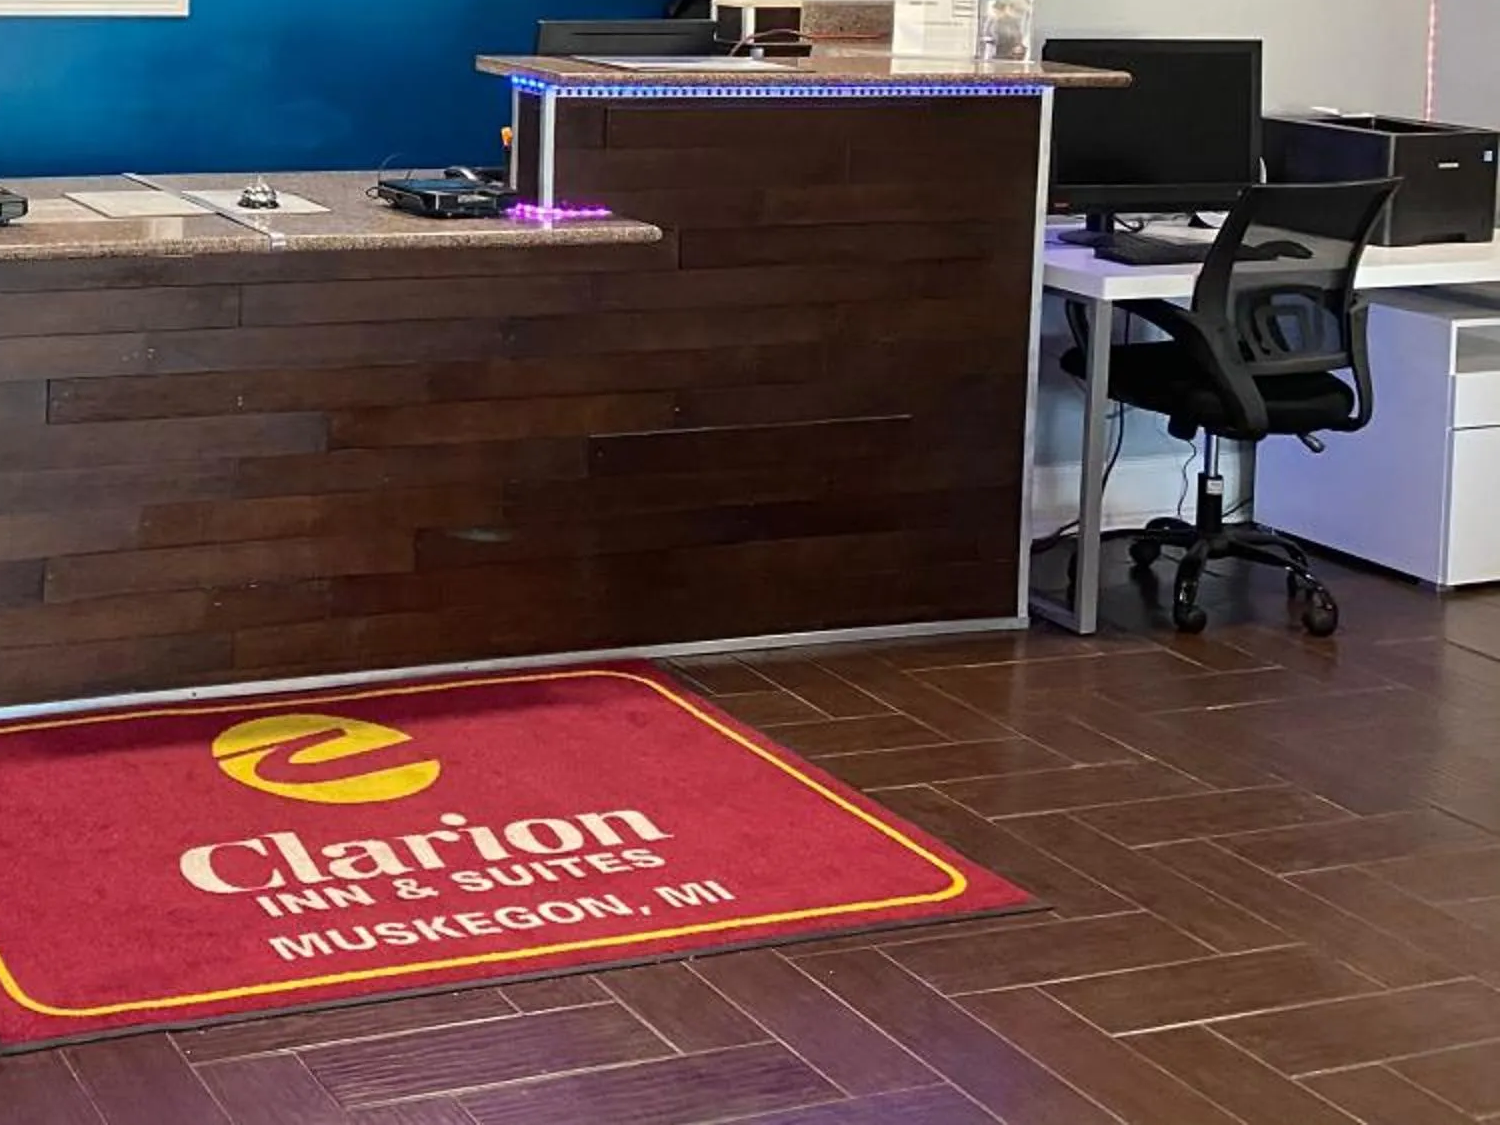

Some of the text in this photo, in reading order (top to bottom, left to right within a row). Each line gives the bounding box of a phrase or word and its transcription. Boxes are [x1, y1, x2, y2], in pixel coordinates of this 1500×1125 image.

[179, 808, 674, 895] Clarion
[256, 848, 666, 918] INN & SUITES
[268, 878, 737, 963] MUSKEGON, MI
